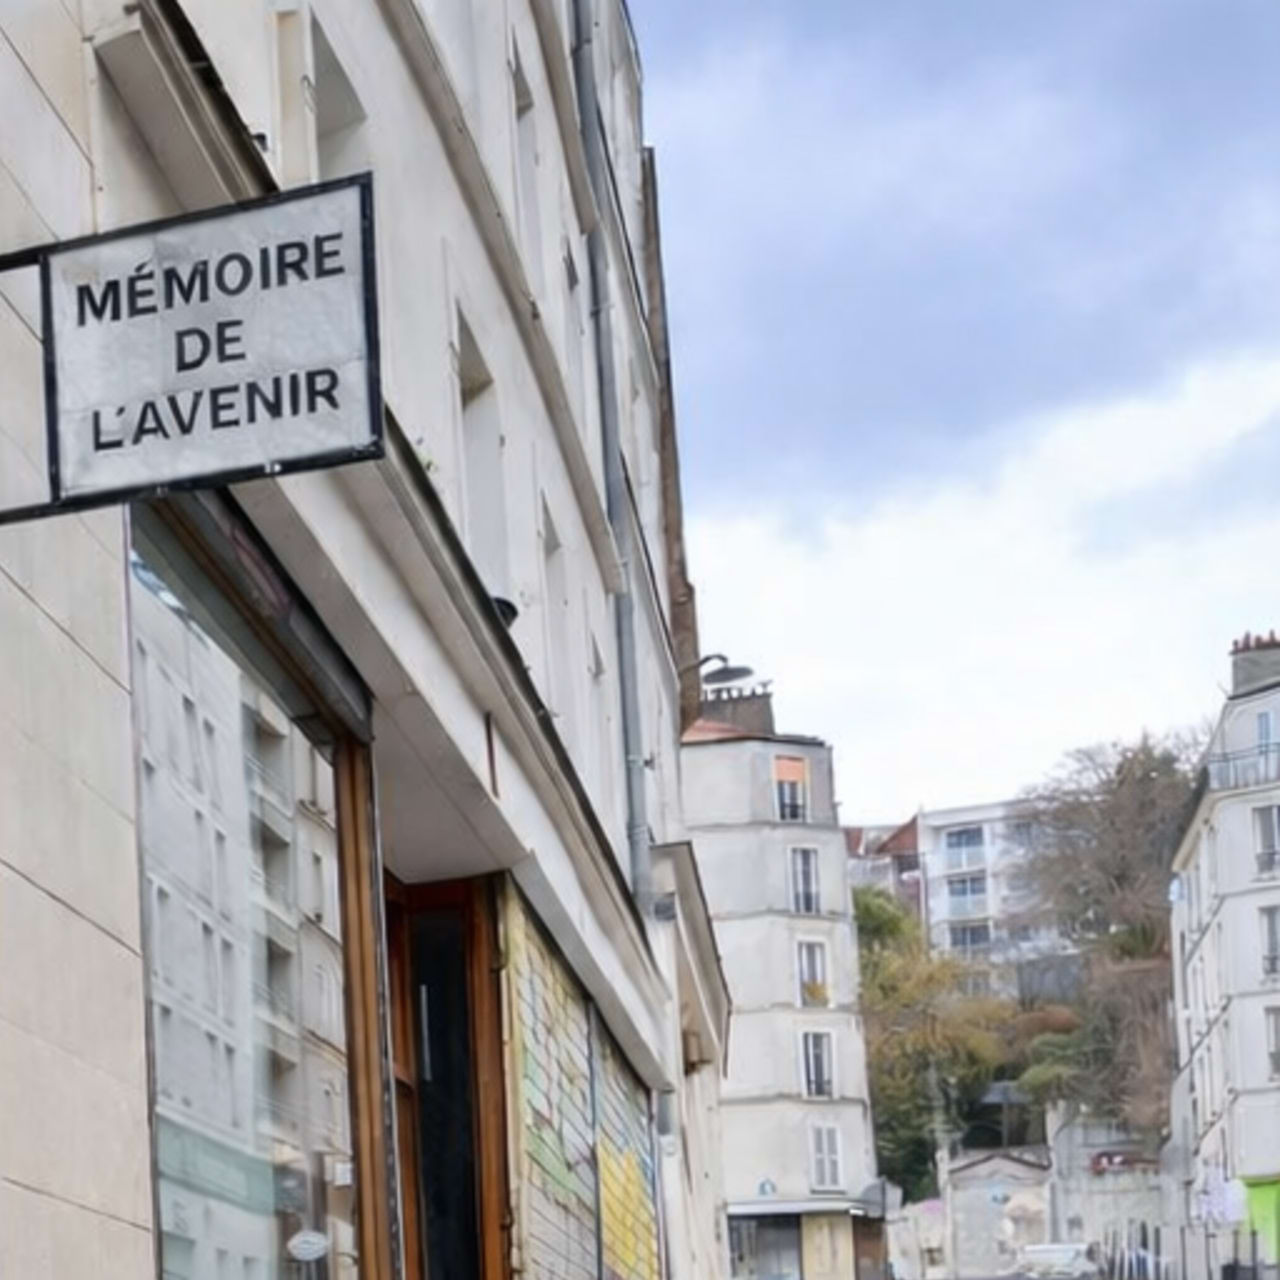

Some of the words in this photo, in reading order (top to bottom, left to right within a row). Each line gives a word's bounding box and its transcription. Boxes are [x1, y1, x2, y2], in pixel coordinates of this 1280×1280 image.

[76, 232, 345, 327] MÉMOIRE
[175, 320, 247, 373] DE
[92, 368, 340, 452] L'AVENIR
